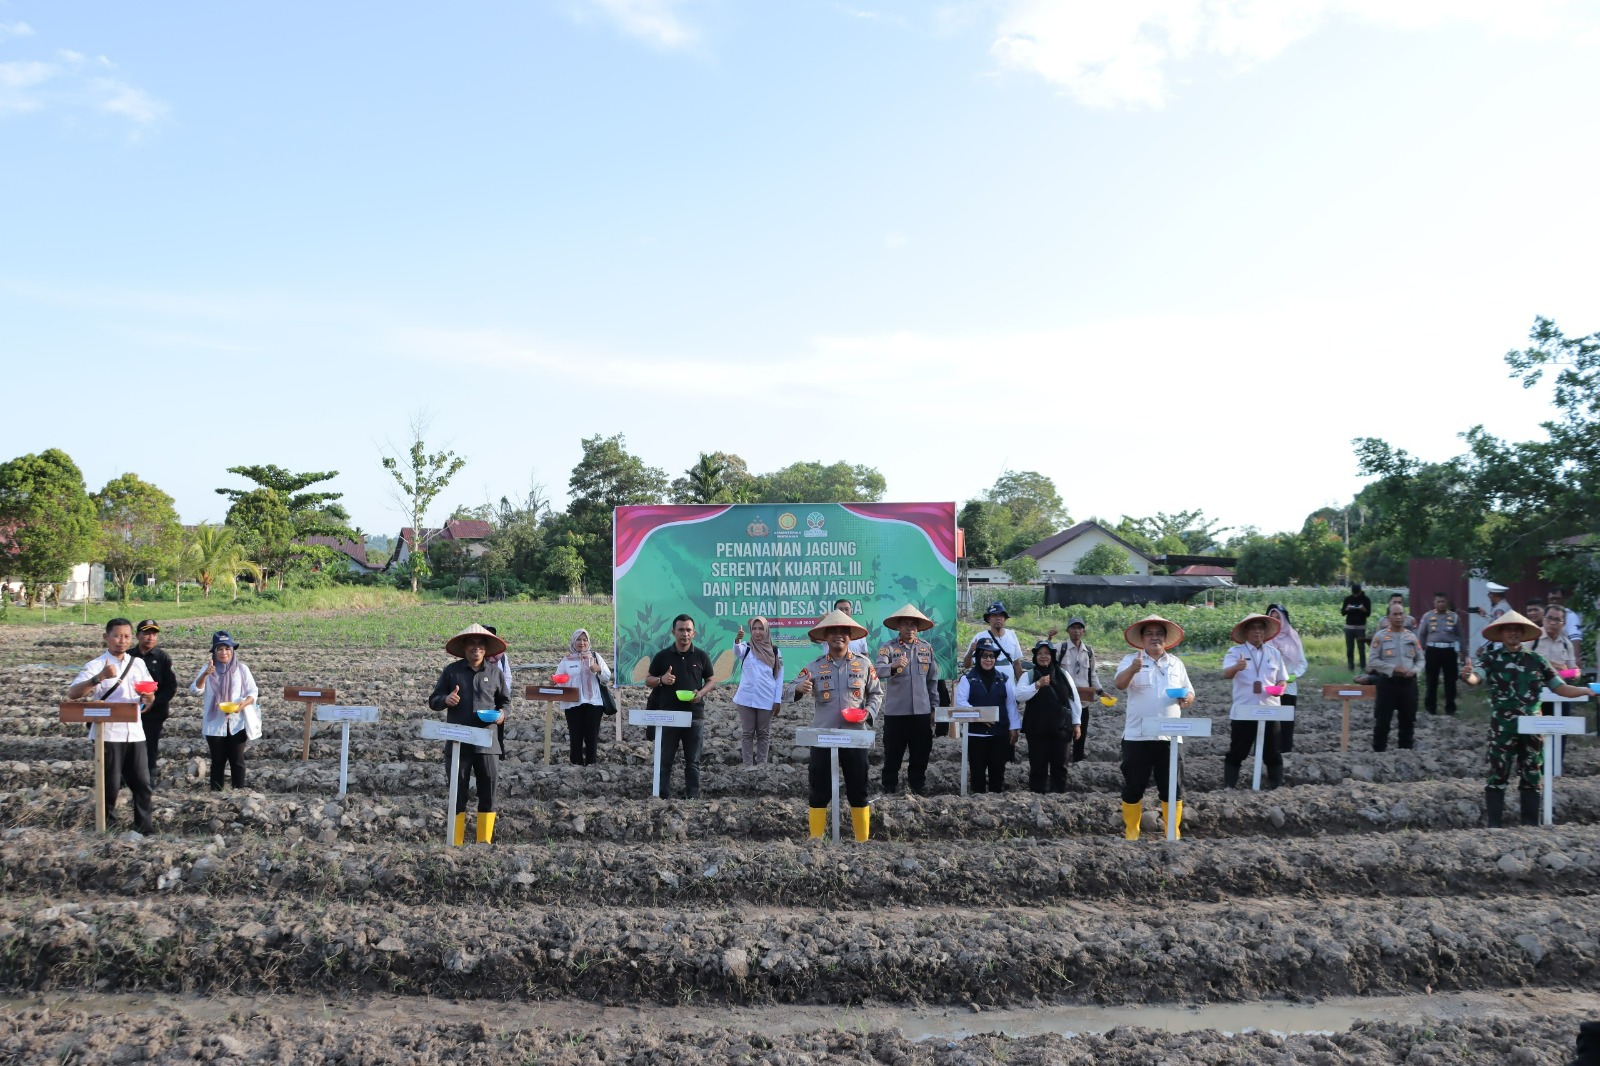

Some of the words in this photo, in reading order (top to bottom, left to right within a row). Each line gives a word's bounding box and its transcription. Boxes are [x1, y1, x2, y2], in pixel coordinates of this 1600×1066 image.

[716, 542, 800, 557] PENANAMAN
[805, 542, 856, 556] JAGUNG
[712, 562, 781, 577] SERENTAK
[785, 562, 845, 576] KUARTAL
[850, 561, 862, 576] III
[703, 582, 730, 596] DAN
[735, 581, 819, 596] PENANAMAN
[823, 580, 875, 595] JAGUNG
[715, 602, 727, 616] DI
[732, 601, 776, 616] LAHAN
[781, 601, 815, 615] DESA
[819, 600, 863, 615] SUA
